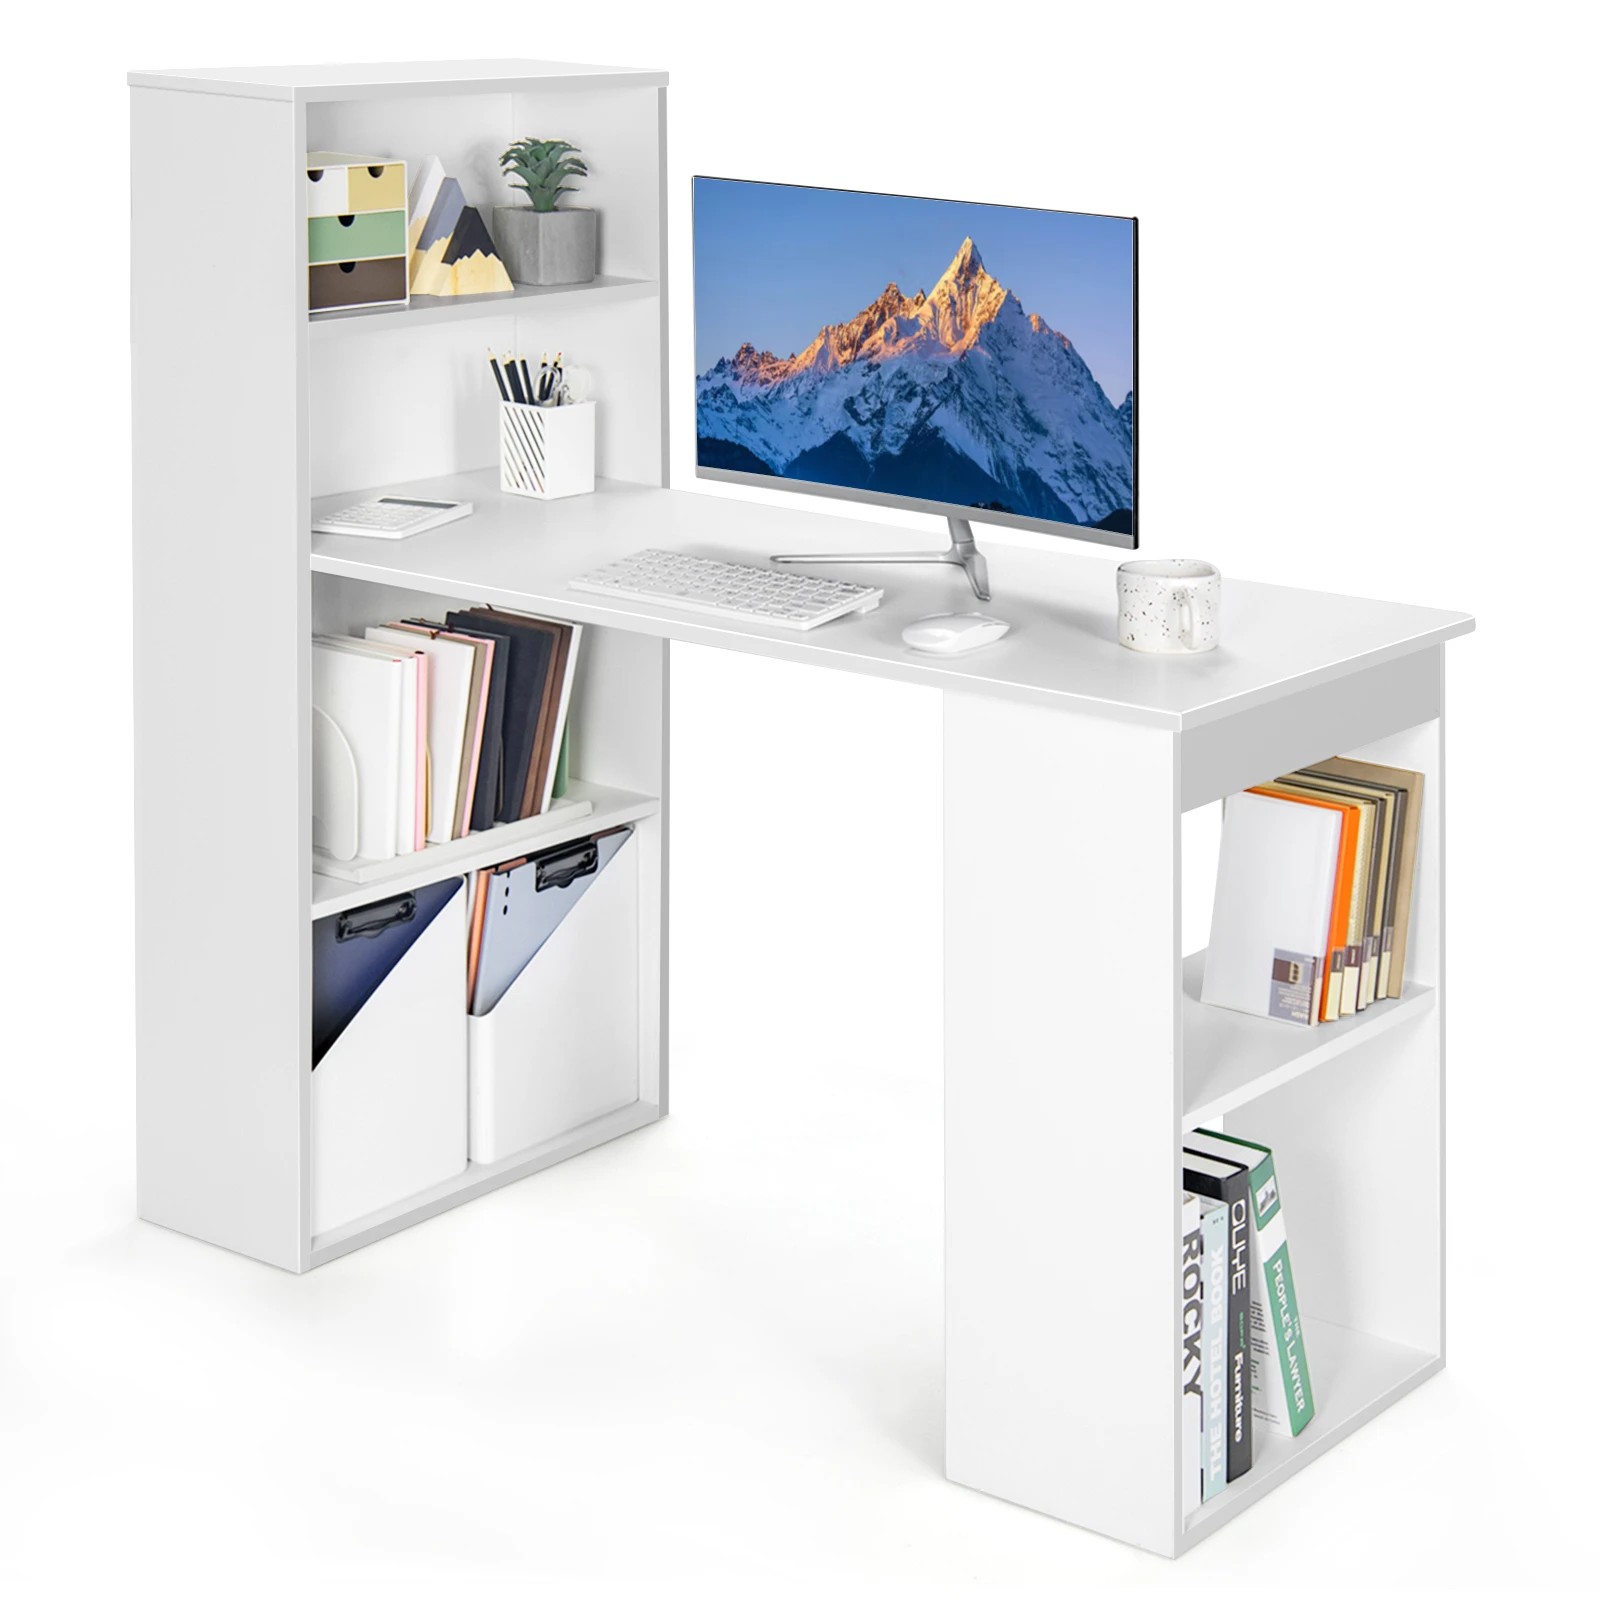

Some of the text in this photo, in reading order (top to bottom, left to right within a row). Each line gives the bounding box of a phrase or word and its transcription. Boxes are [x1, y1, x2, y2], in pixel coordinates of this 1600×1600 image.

[1183, 1228, 1203, 1401] ROCKY
[1210, 1244, 1224, 1482] THE HOTEL BOOK
[1272, 1258, 1306, 1413] PEOPLE'S LAWYER
[1293, 1315, 1301, 1339] THE
[1234, 1351, 1243, 1443] Furniture
